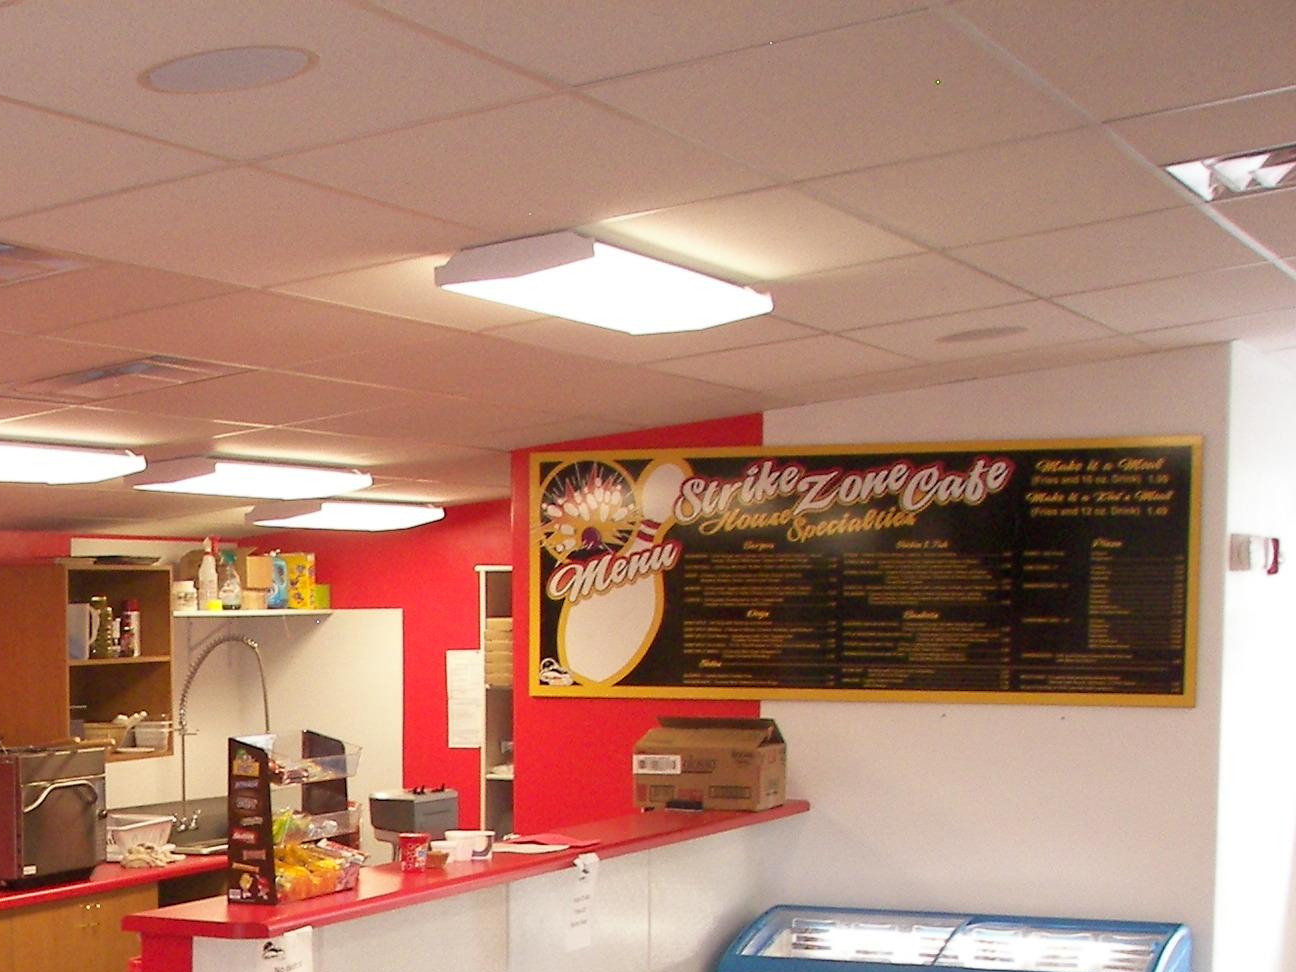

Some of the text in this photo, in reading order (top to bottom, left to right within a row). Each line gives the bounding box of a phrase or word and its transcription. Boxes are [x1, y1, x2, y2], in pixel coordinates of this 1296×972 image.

[674, 460, 800, 525] Strike
[792, 462, 911, 517] Zone
[699, 508, 793, 536] House
[547, 542, 680, 604] Menu
